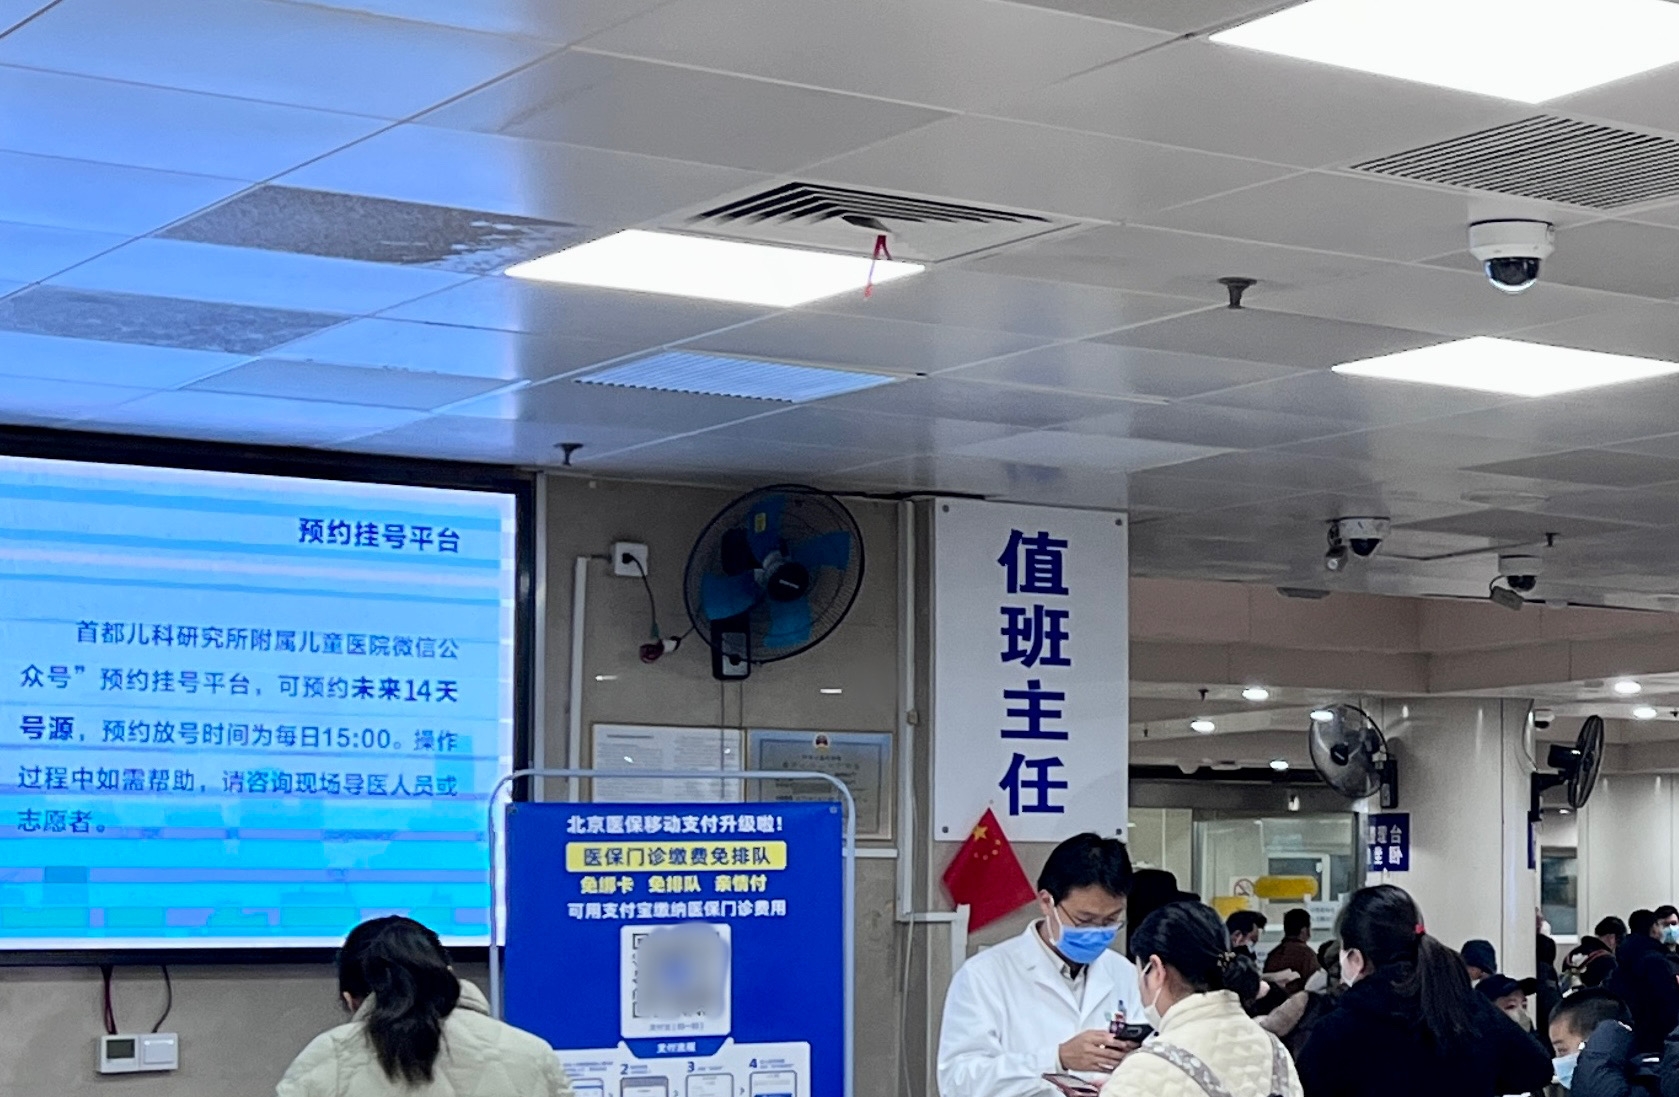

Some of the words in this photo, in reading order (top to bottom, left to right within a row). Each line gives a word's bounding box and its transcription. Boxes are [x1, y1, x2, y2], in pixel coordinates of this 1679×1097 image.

[299, 517, 461, 554] 预约挂号平台
[76, 620, 459, 660] 首都儿科研究所附属儿童医院微信公
[997, 528, 1071, 816] 值班主任
[17, 765, 458, 797] 过程中如需帮助，请咨询现场导医人员或
[583, 846, 772, 867] 医保门诊缴费免排队
[620, 1064, 628, 1075] 2
[687, 1061, 695, 1072] 3
[749, 1058, 758, 1069] 4
